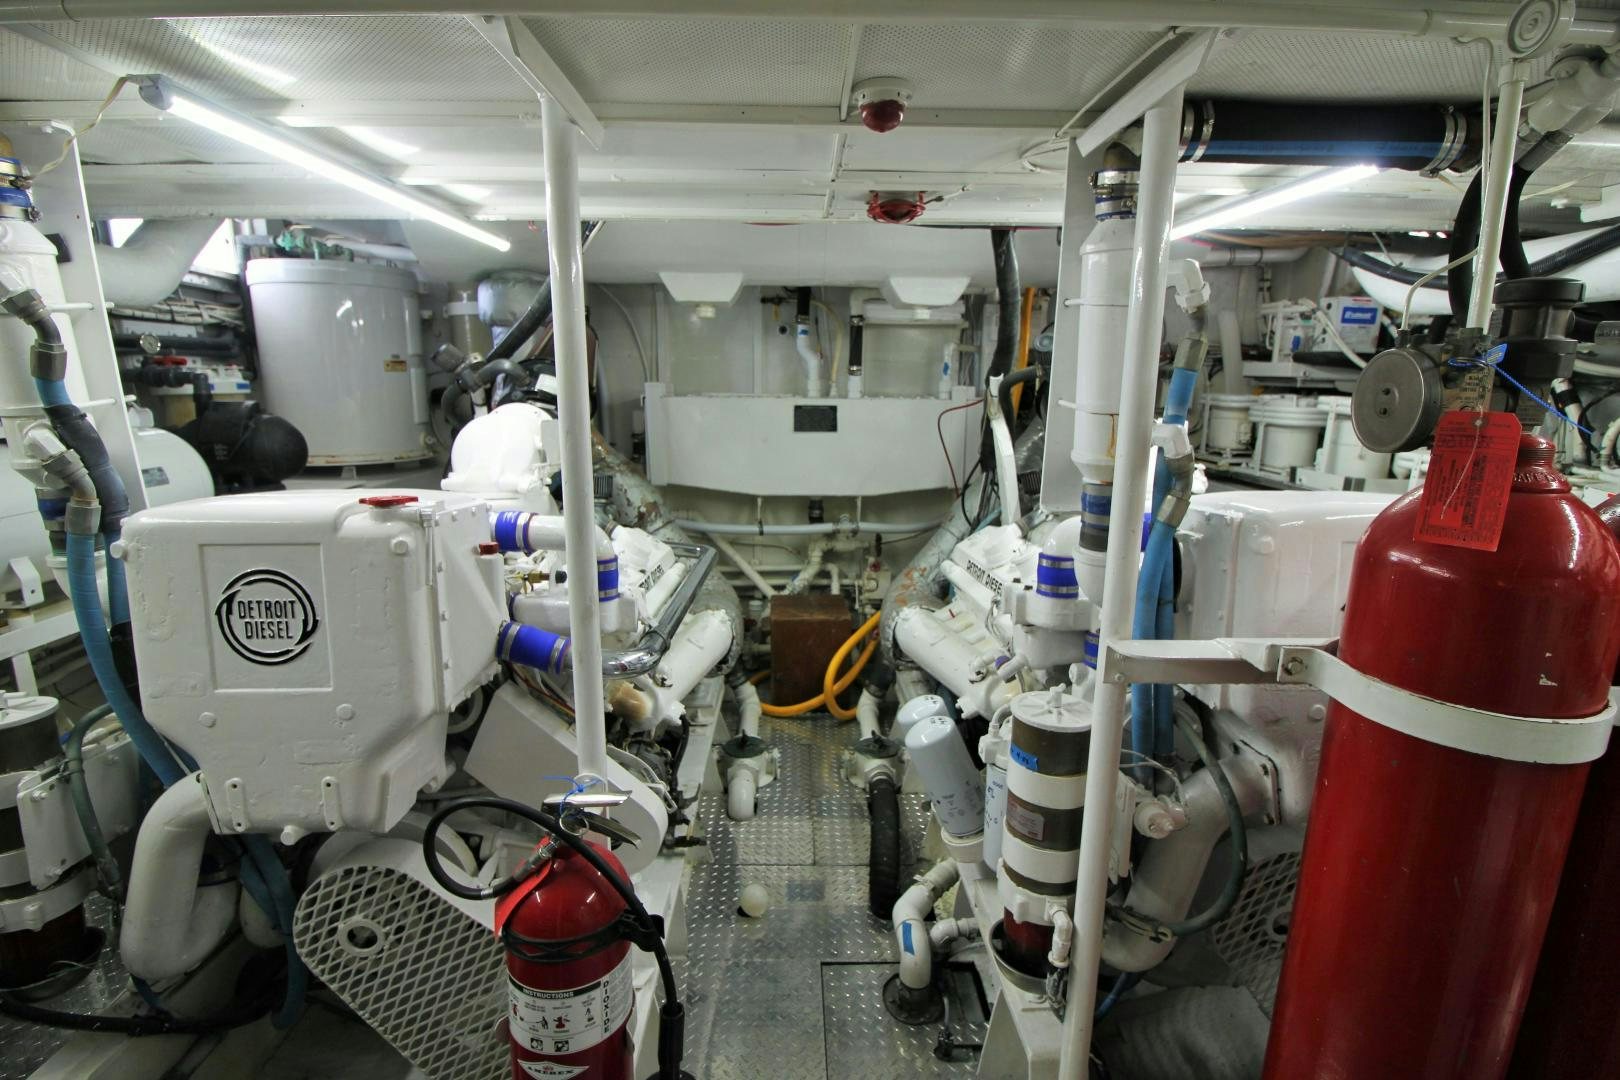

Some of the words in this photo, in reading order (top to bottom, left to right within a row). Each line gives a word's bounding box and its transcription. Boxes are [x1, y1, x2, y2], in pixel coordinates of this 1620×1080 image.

[237, 600, 296, 619] DETROIT
[244, 621, 294, 640] DIESEL
[522, 987, 574, 999] INSTRUCTIONS
